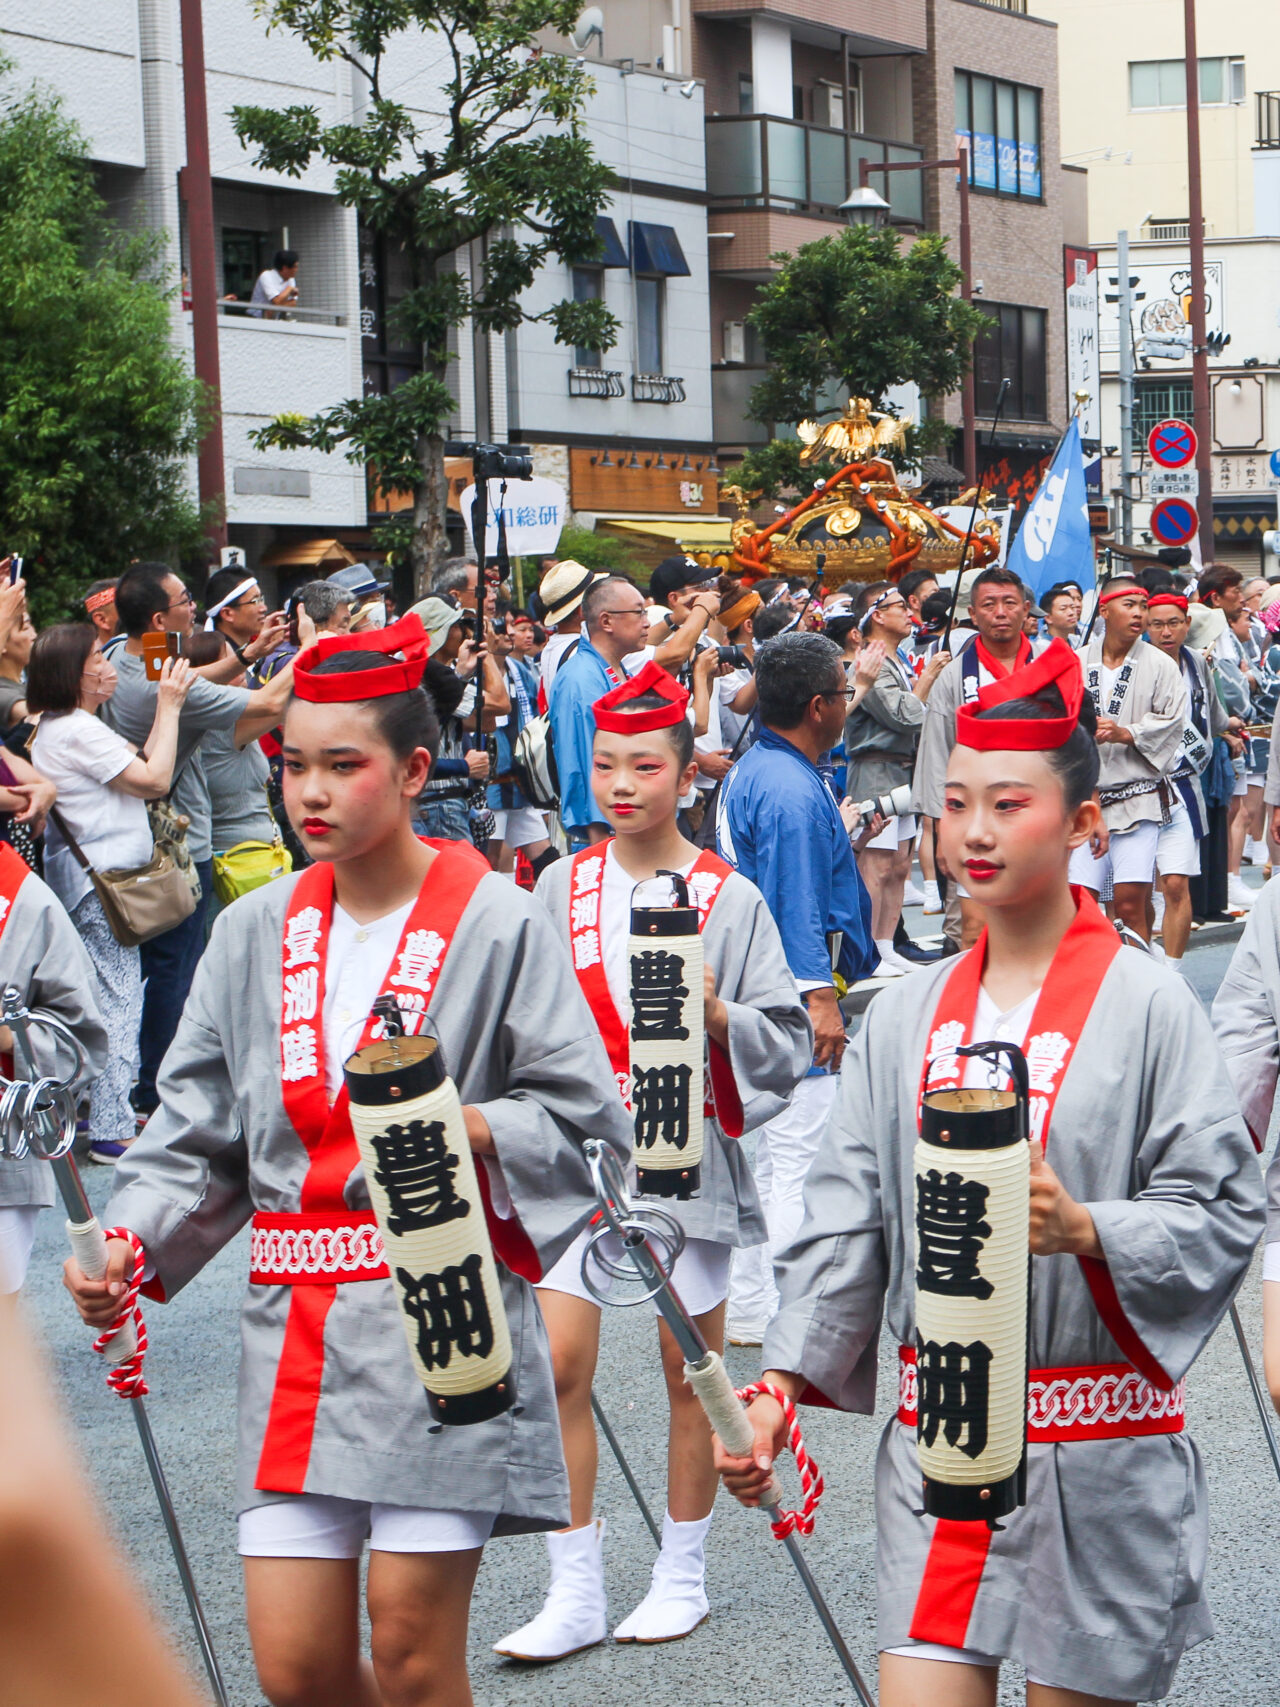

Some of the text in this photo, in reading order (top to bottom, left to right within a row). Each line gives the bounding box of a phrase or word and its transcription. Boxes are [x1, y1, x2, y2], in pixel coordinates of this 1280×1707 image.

[1245, 456, 1257, 489] 水餃子
[629, 949, 693, 1151] 豊洲
[369, 1119, 494, 1372] 豊洲
[915, 1168, 995, 1460] 豊洲
